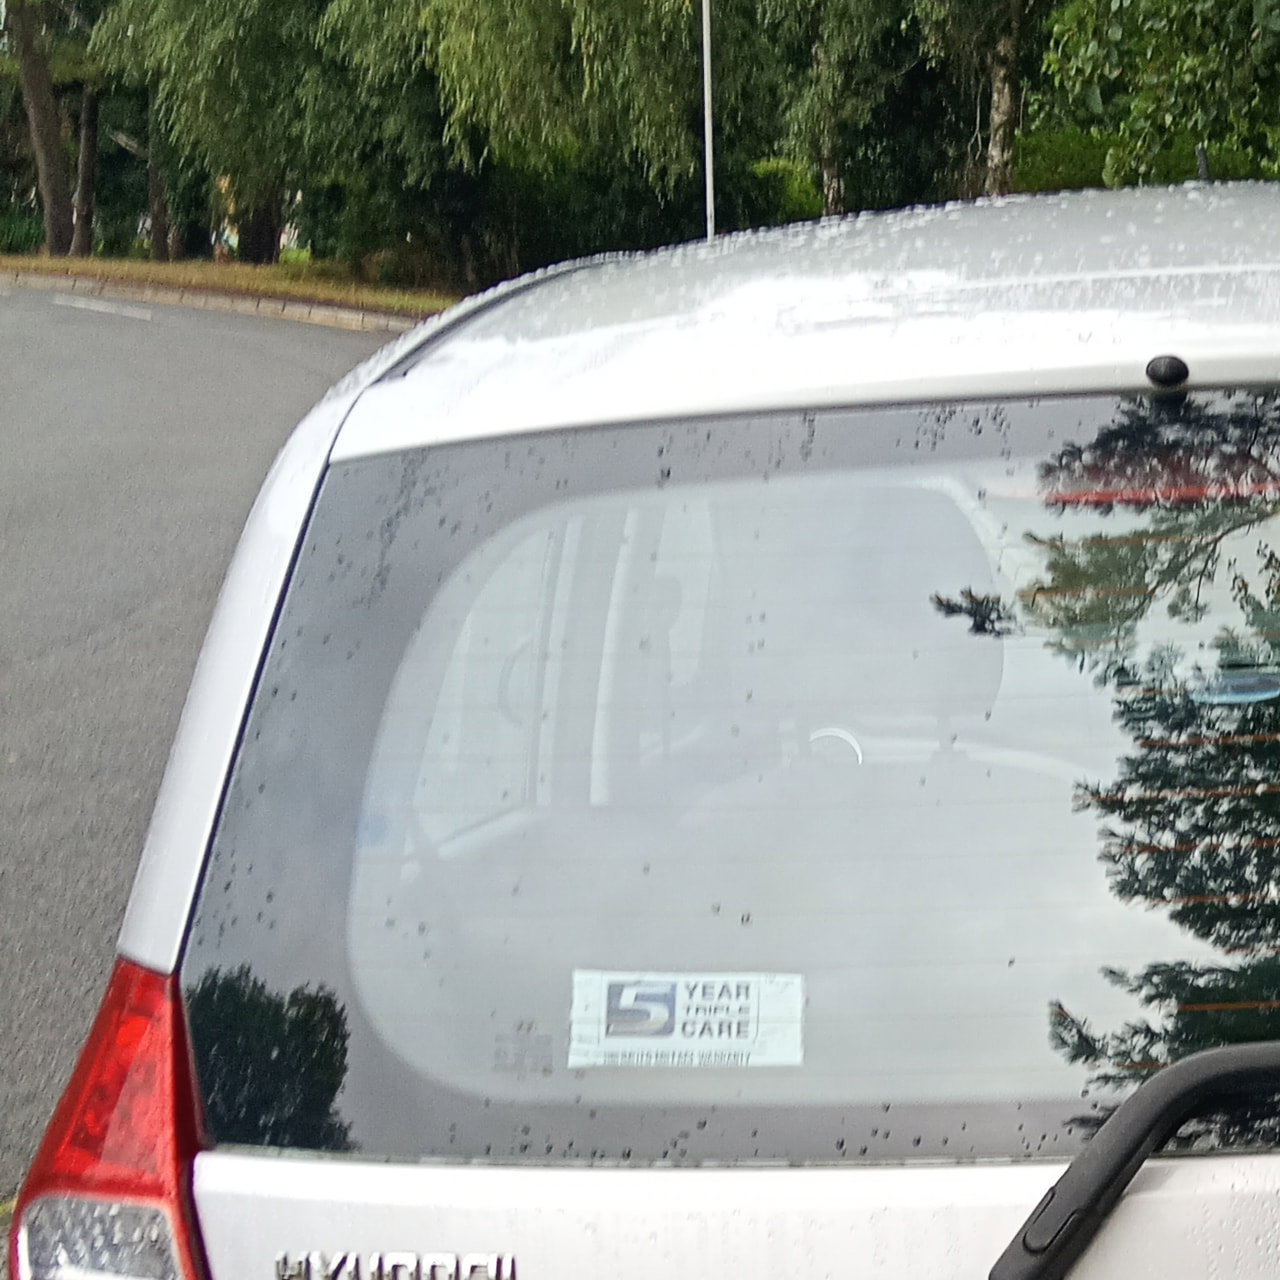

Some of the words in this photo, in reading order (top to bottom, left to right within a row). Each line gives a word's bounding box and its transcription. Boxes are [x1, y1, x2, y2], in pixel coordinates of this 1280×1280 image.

[682, 982, 751, 1000] YEAR
[682, 1004, 750, 1017] TRIPLE
[681, 1020, 750, 1038] CARE
